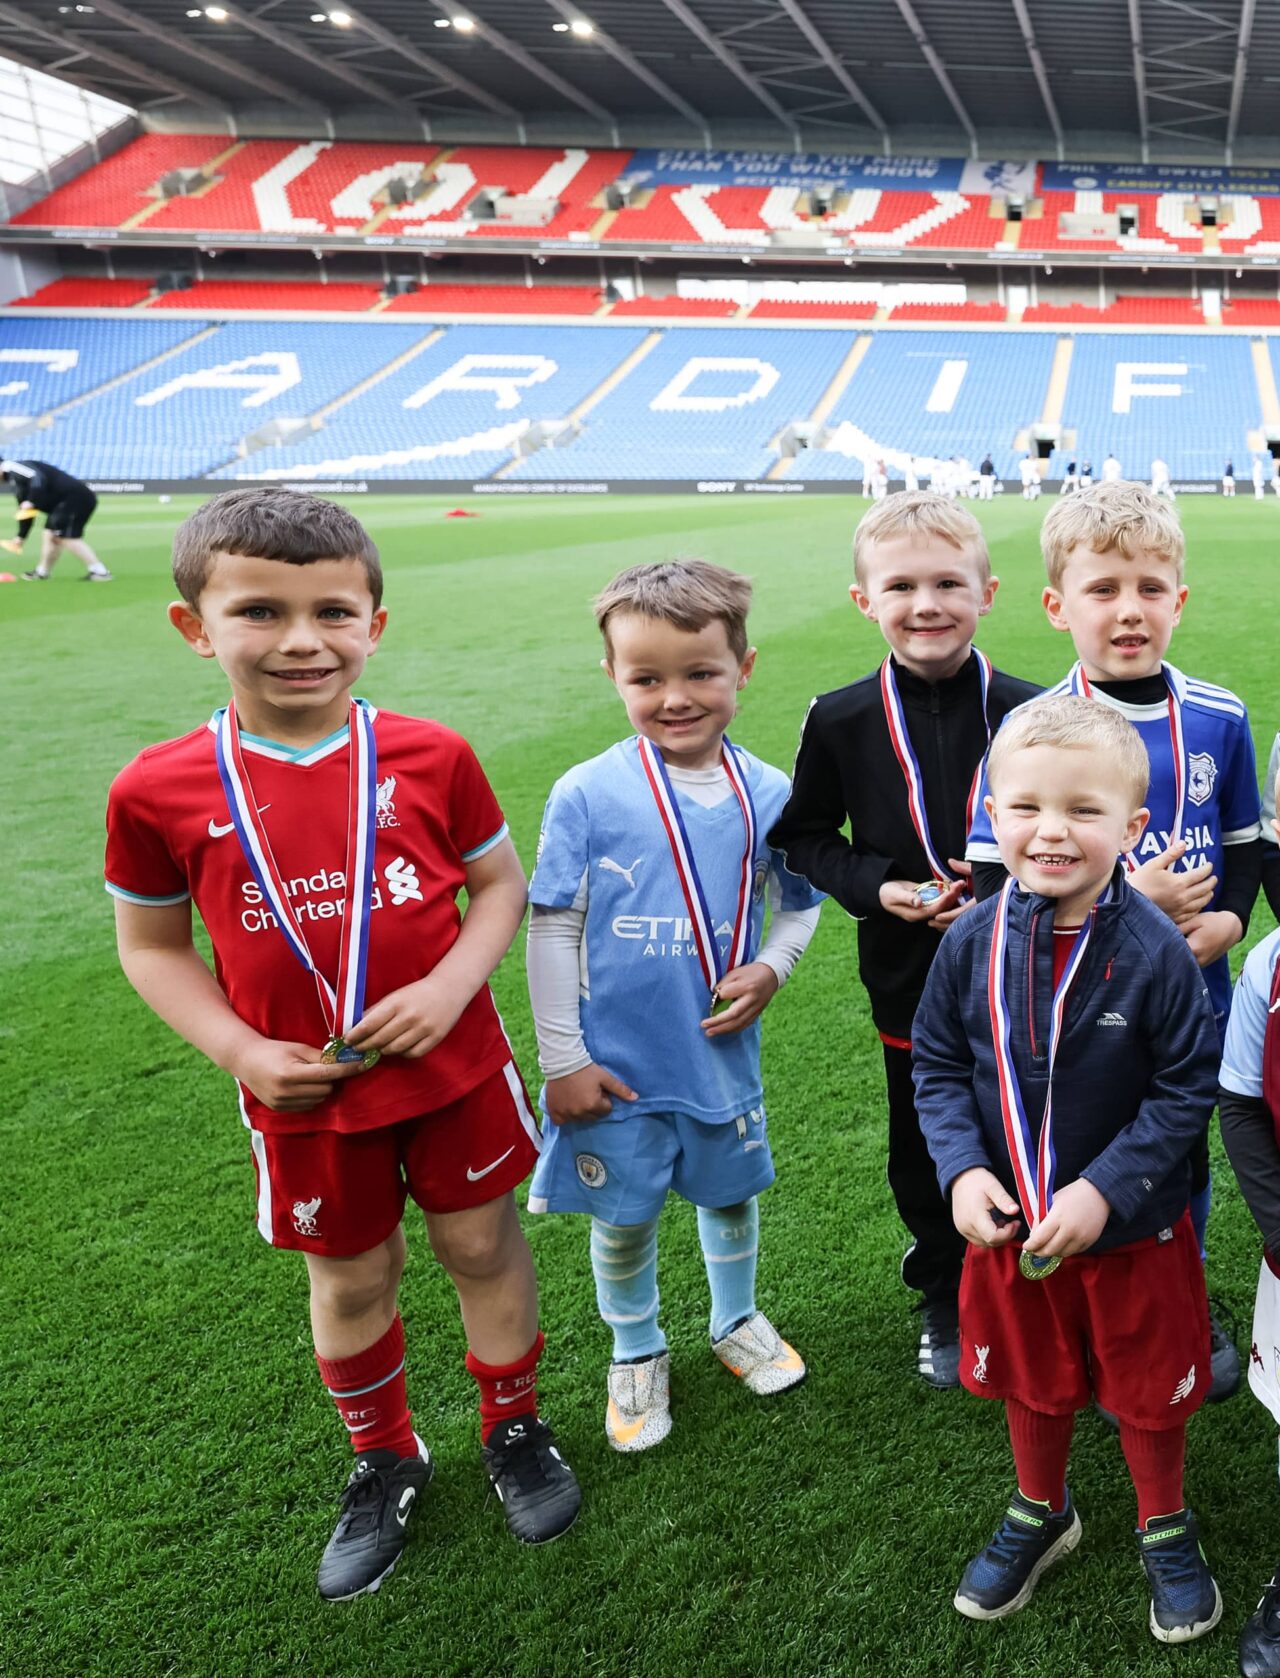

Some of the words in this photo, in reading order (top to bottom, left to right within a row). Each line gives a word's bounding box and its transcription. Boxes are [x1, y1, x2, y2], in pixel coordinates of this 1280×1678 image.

[656, 161, 722, 172] THAN
[733, 162, 779, 174] YOU
[789, 163, 854, 177] WILL
[863, 165, 939, 178] KNOW
[1058, 164, 1099, 174] PHIL
[1106, 178, 1170, 190] CARDIFF
[1140, 825, 1214, 856] AYSIA
[241, 866, 377, 904] Snda
[241, 888, 383, 932] Chrterd
[612, 915, 755, 941] ETIA
[643, 943, 729, 957] AIRWY
[1096, 1019, 1127, 1027] TRESPASS
[1143, 1526, 1187, 1544] SKECHERS
